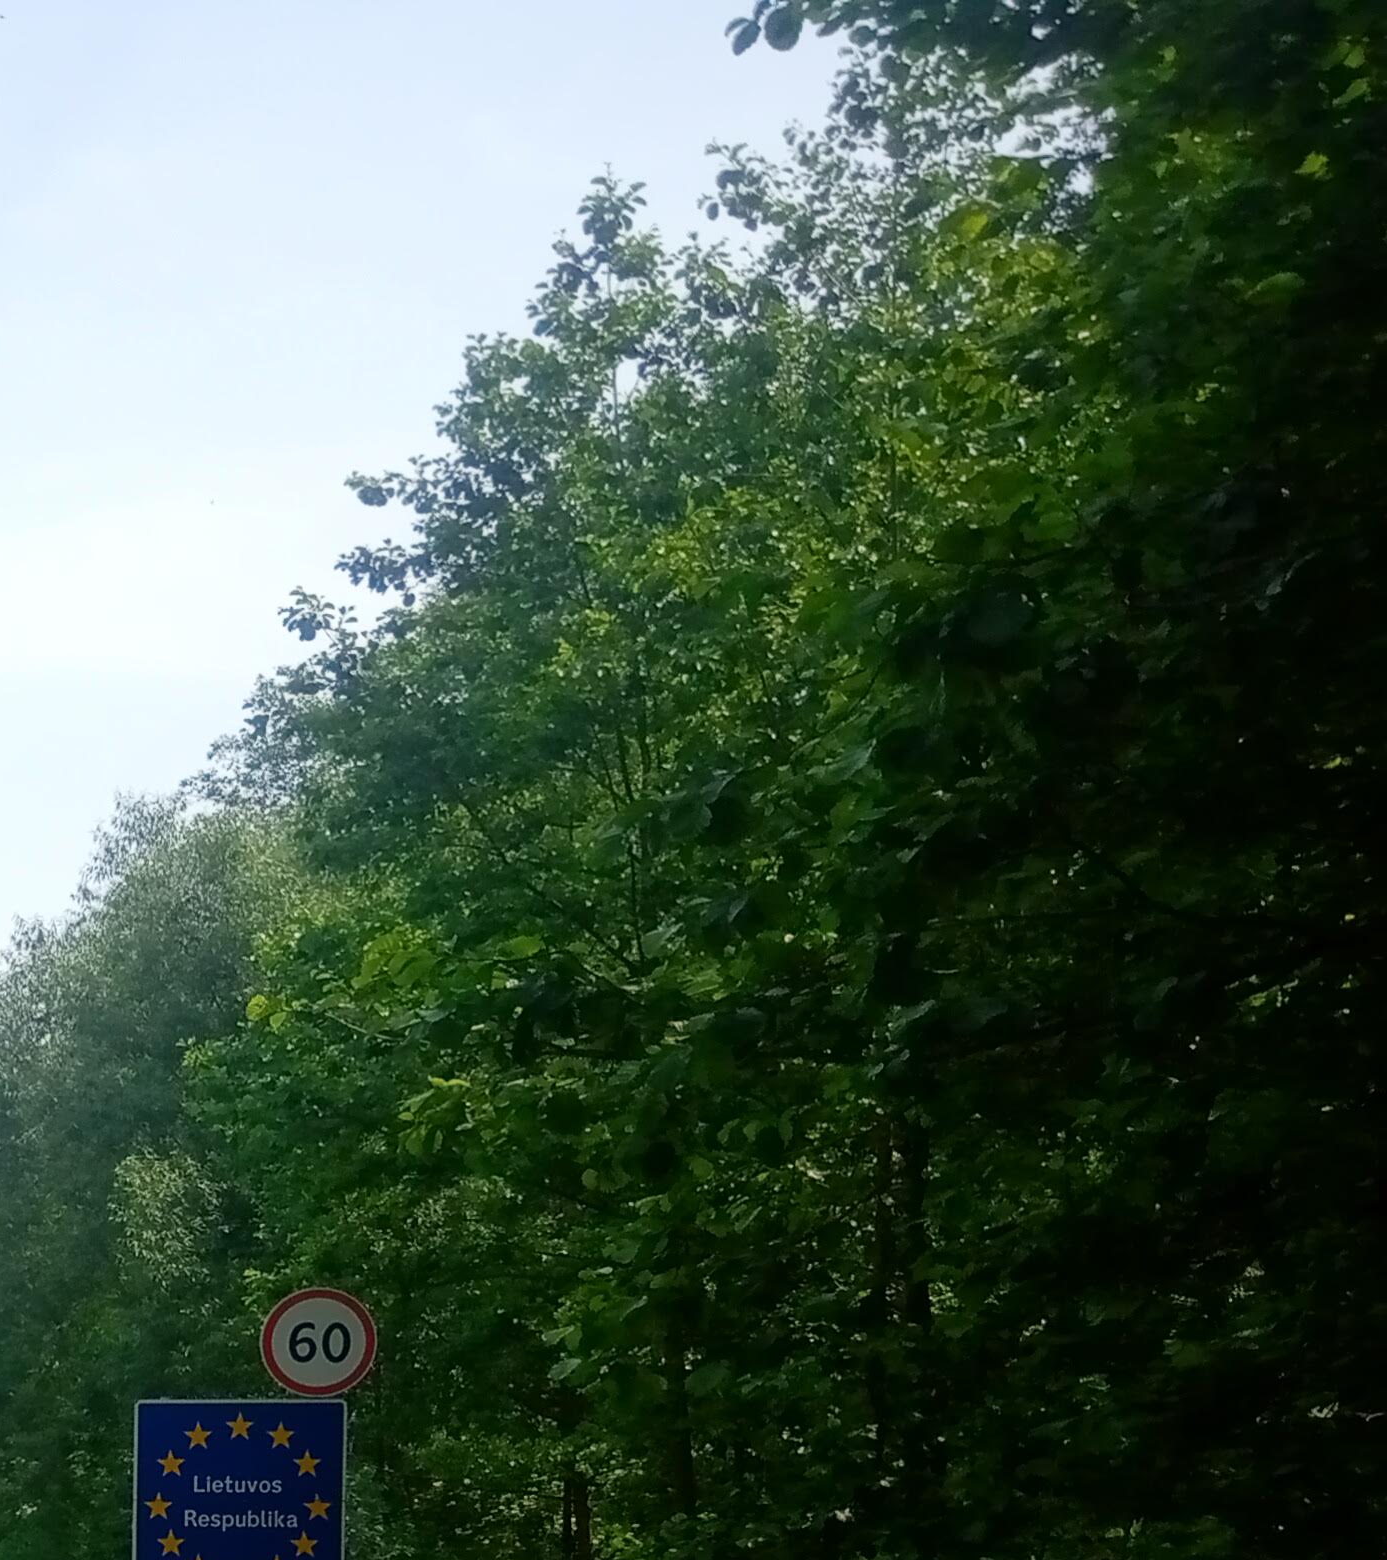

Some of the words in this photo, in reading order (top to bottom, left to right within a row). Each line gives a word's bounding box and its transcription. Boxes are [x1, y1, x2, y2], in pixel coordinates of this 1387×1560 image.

[288, 1322, 351, 1363] 60
[193, 1475, 283, 1493] Lietuvos
[184, 1509, 299, 1531] Respublika
